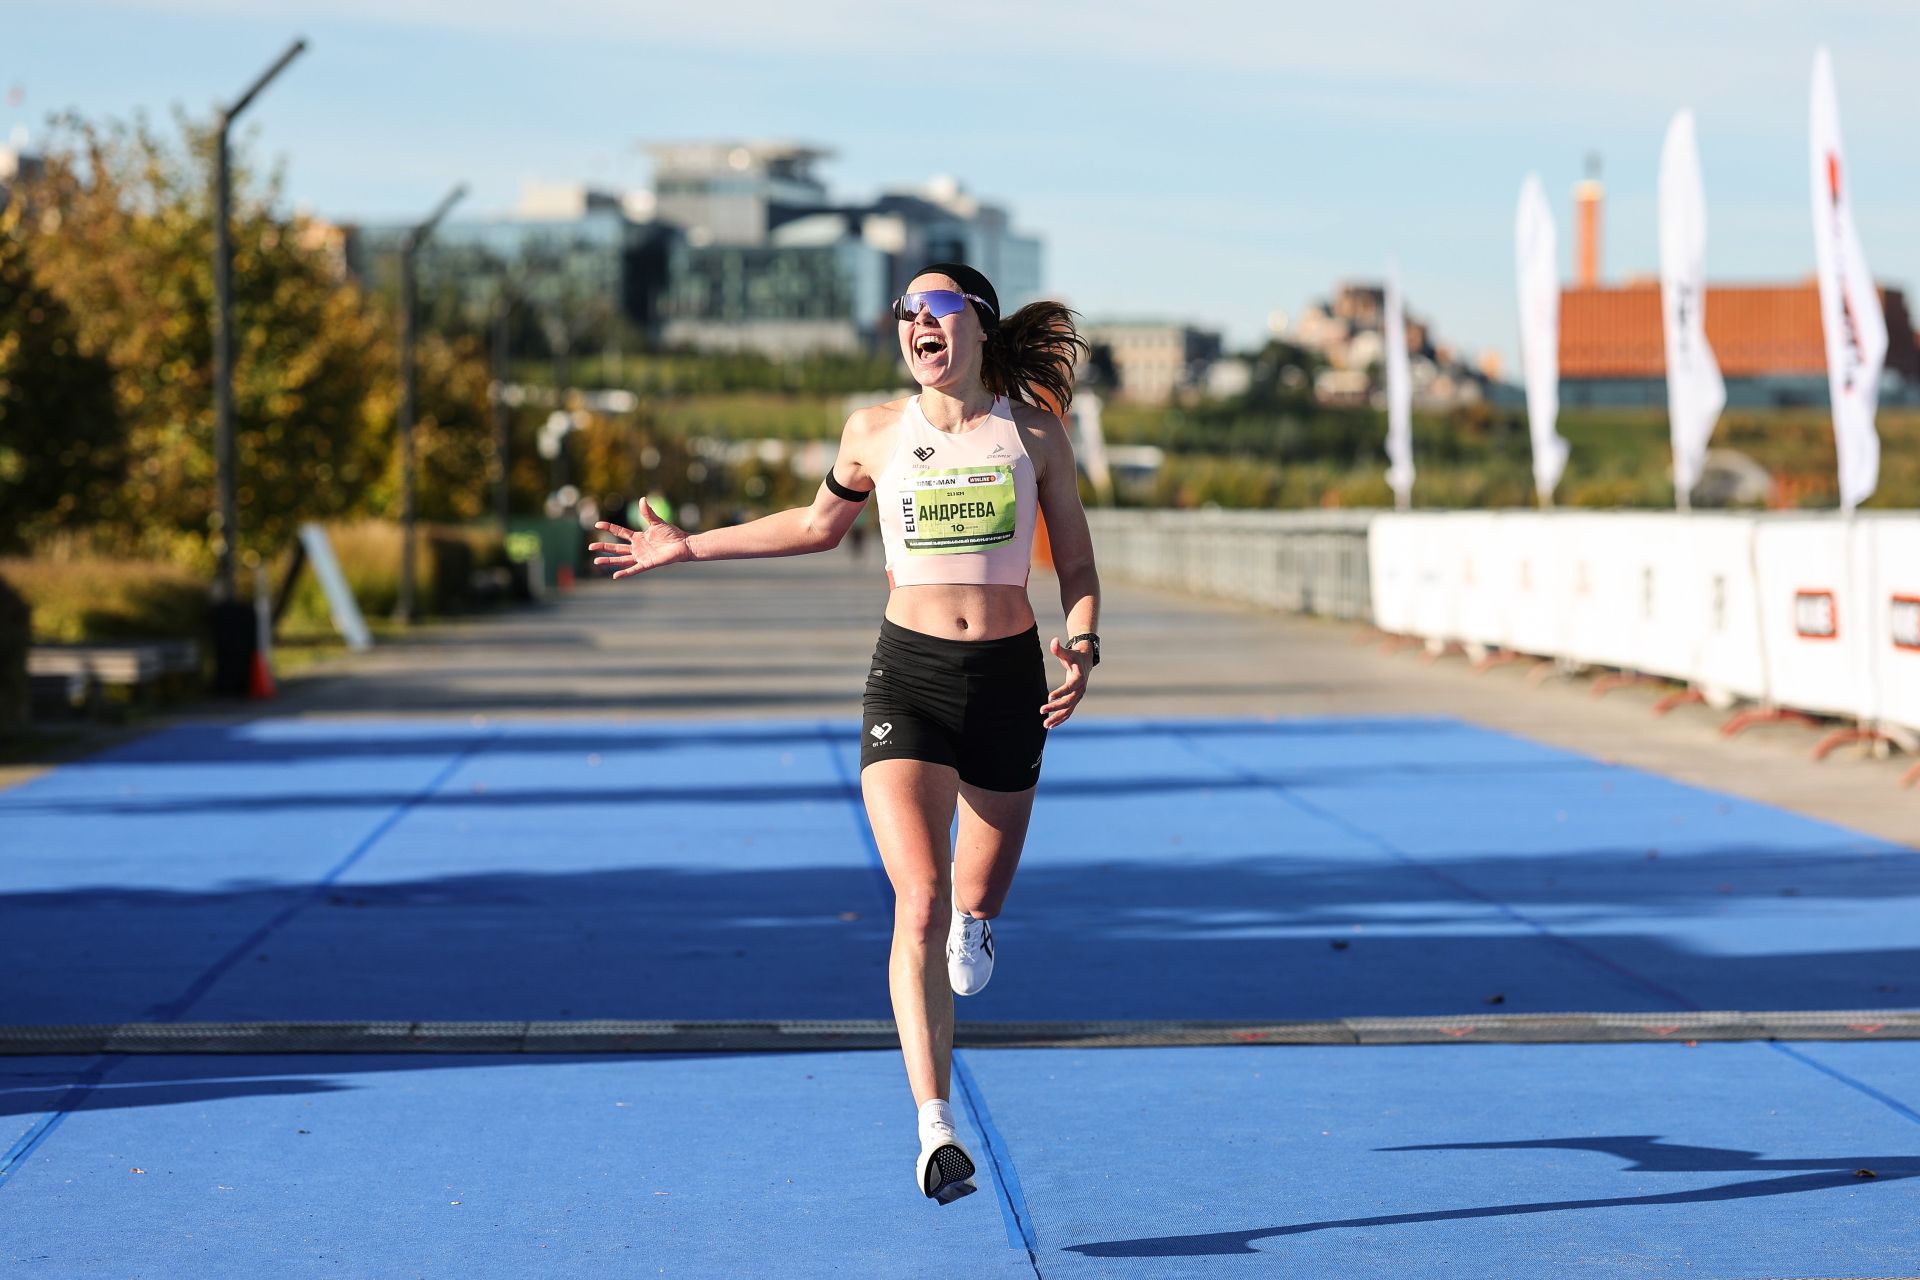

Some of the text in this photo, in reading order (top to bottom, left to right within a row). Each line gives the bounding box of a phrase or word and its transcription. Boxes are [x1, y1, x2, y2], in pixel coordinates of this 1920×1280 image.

[902, 497, 916, 533] ELITE
[919, 501, 996, 521] АНДРЕЕВА
[950, 524, 965, 532] 10
